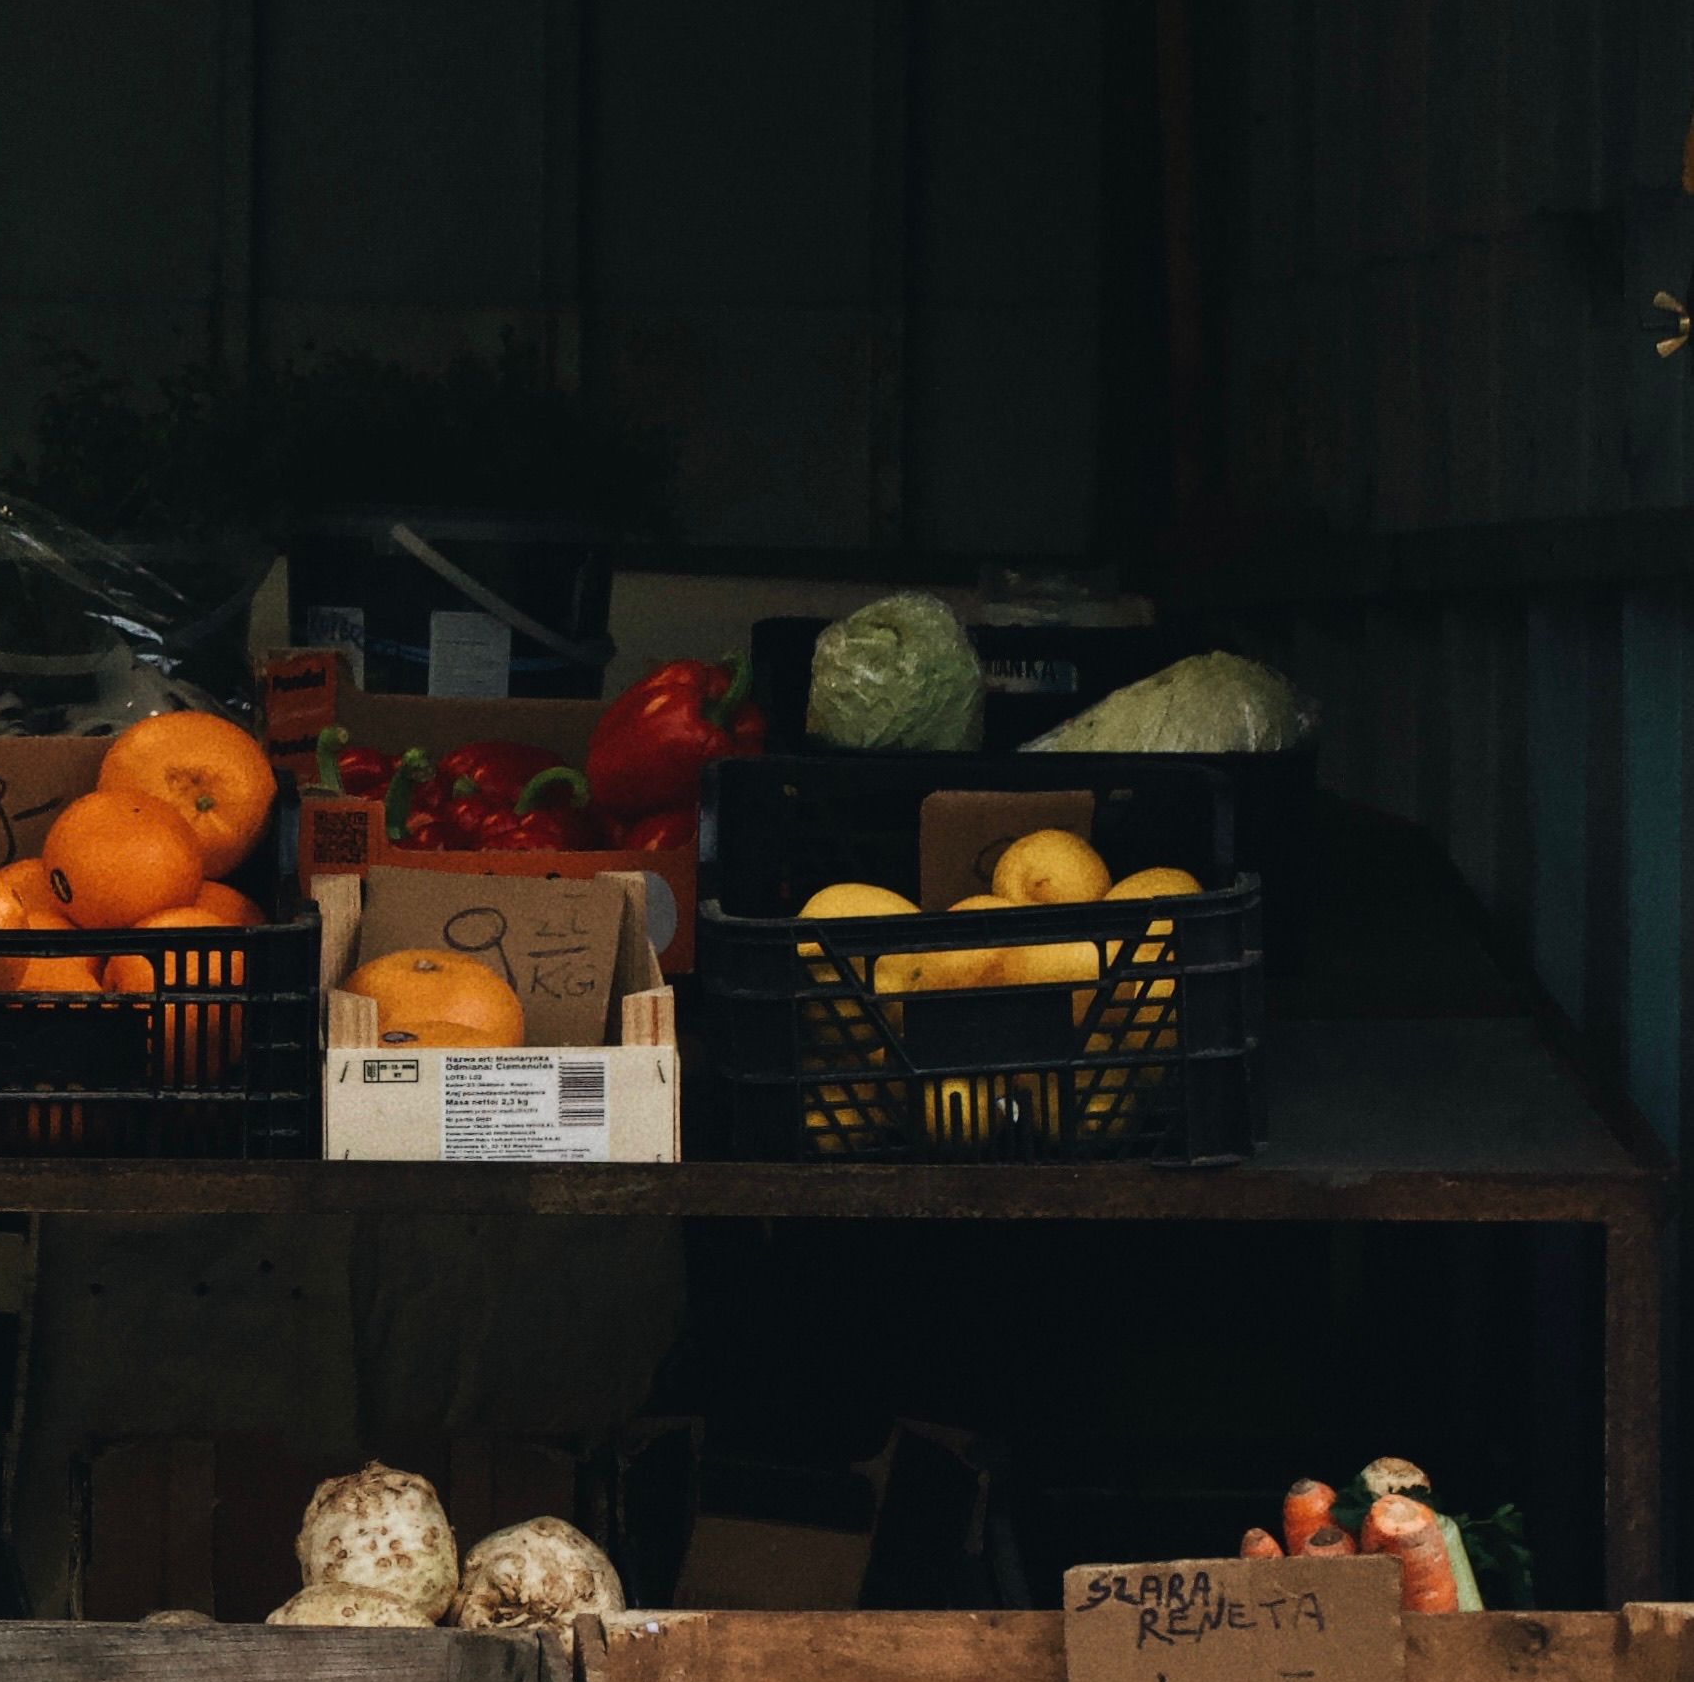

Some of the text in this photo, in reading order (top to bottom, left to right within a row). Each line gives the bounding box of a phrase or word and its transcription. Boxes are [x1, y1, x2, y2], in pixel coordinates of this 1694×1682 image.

[443, 906, 517, 991] 9
[529, 961, 597, 1000] KG
[517, 1098, 529, 1107] kg
[1076, 1571, 1212, 1612] SZARA
[1137, 1582, 1325, 1649] RENETA
